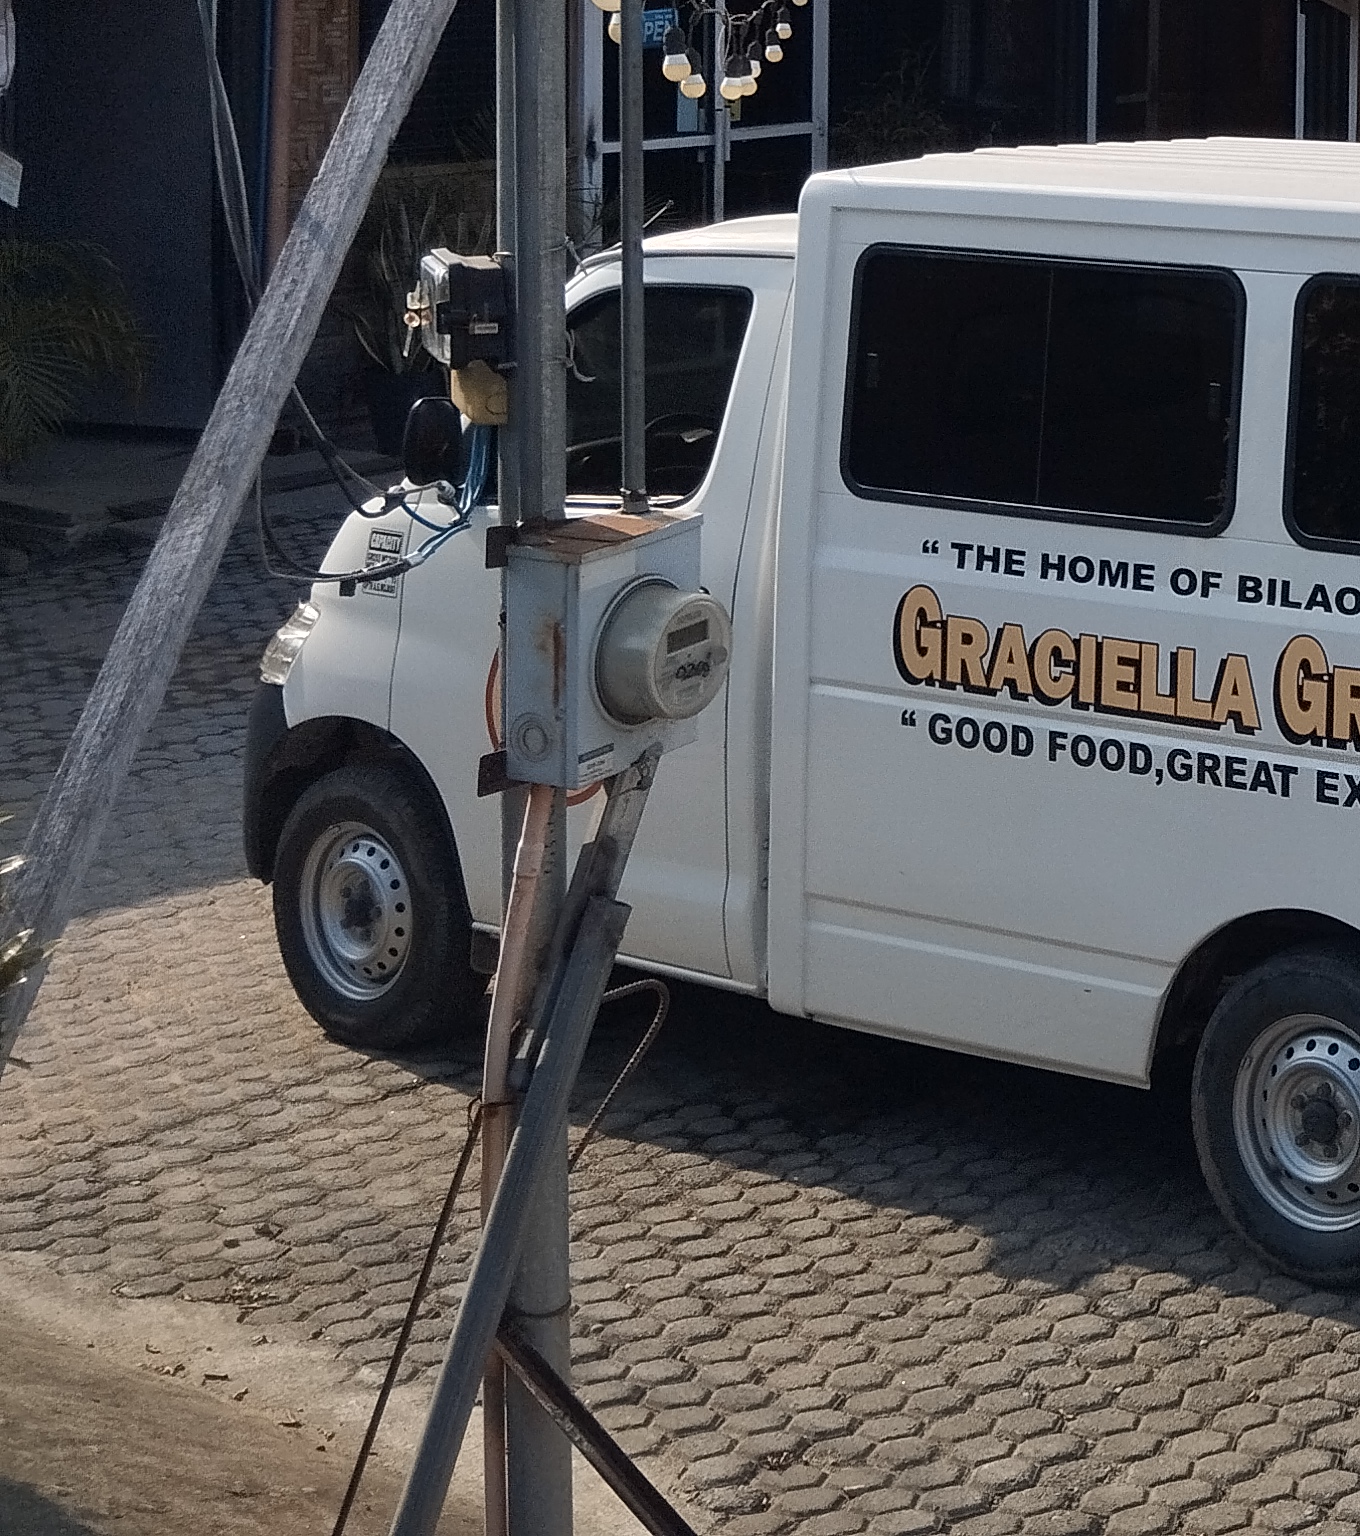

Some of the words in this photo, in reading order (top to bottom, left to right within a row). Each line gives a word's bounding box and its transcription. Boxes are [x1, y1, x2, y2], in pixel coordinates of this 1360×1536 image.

[1039, 552, 1155, 592] HOME
[1170, 568, 1222, 599] OF
[892, 584, 1262, 736] GRACIELLA
